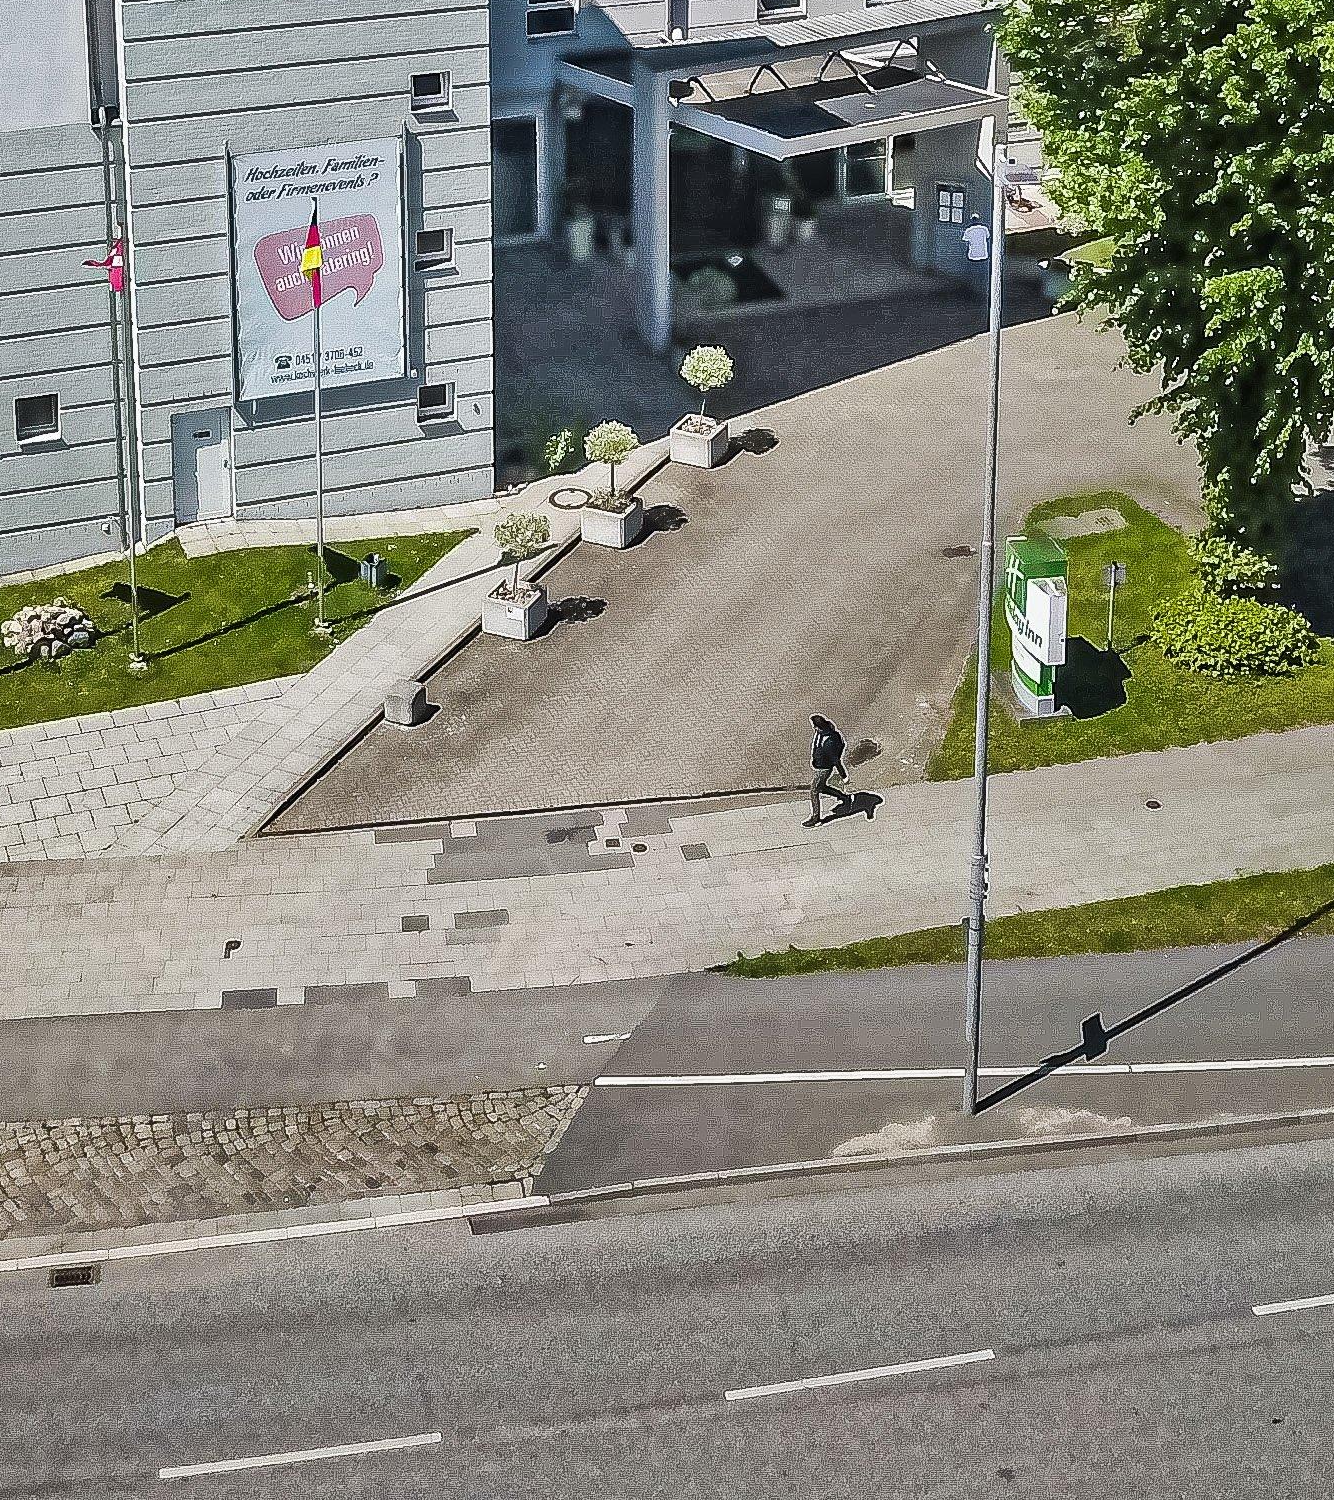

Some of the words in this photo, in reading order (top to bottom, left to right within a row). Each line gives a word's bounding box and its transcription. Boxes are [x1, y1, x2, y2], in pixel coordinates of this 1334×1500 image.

[322, 154, 385, 175] Familien-
[245, 185, 276, 201] oder
[1025, 619, 1042, 649] Inn
